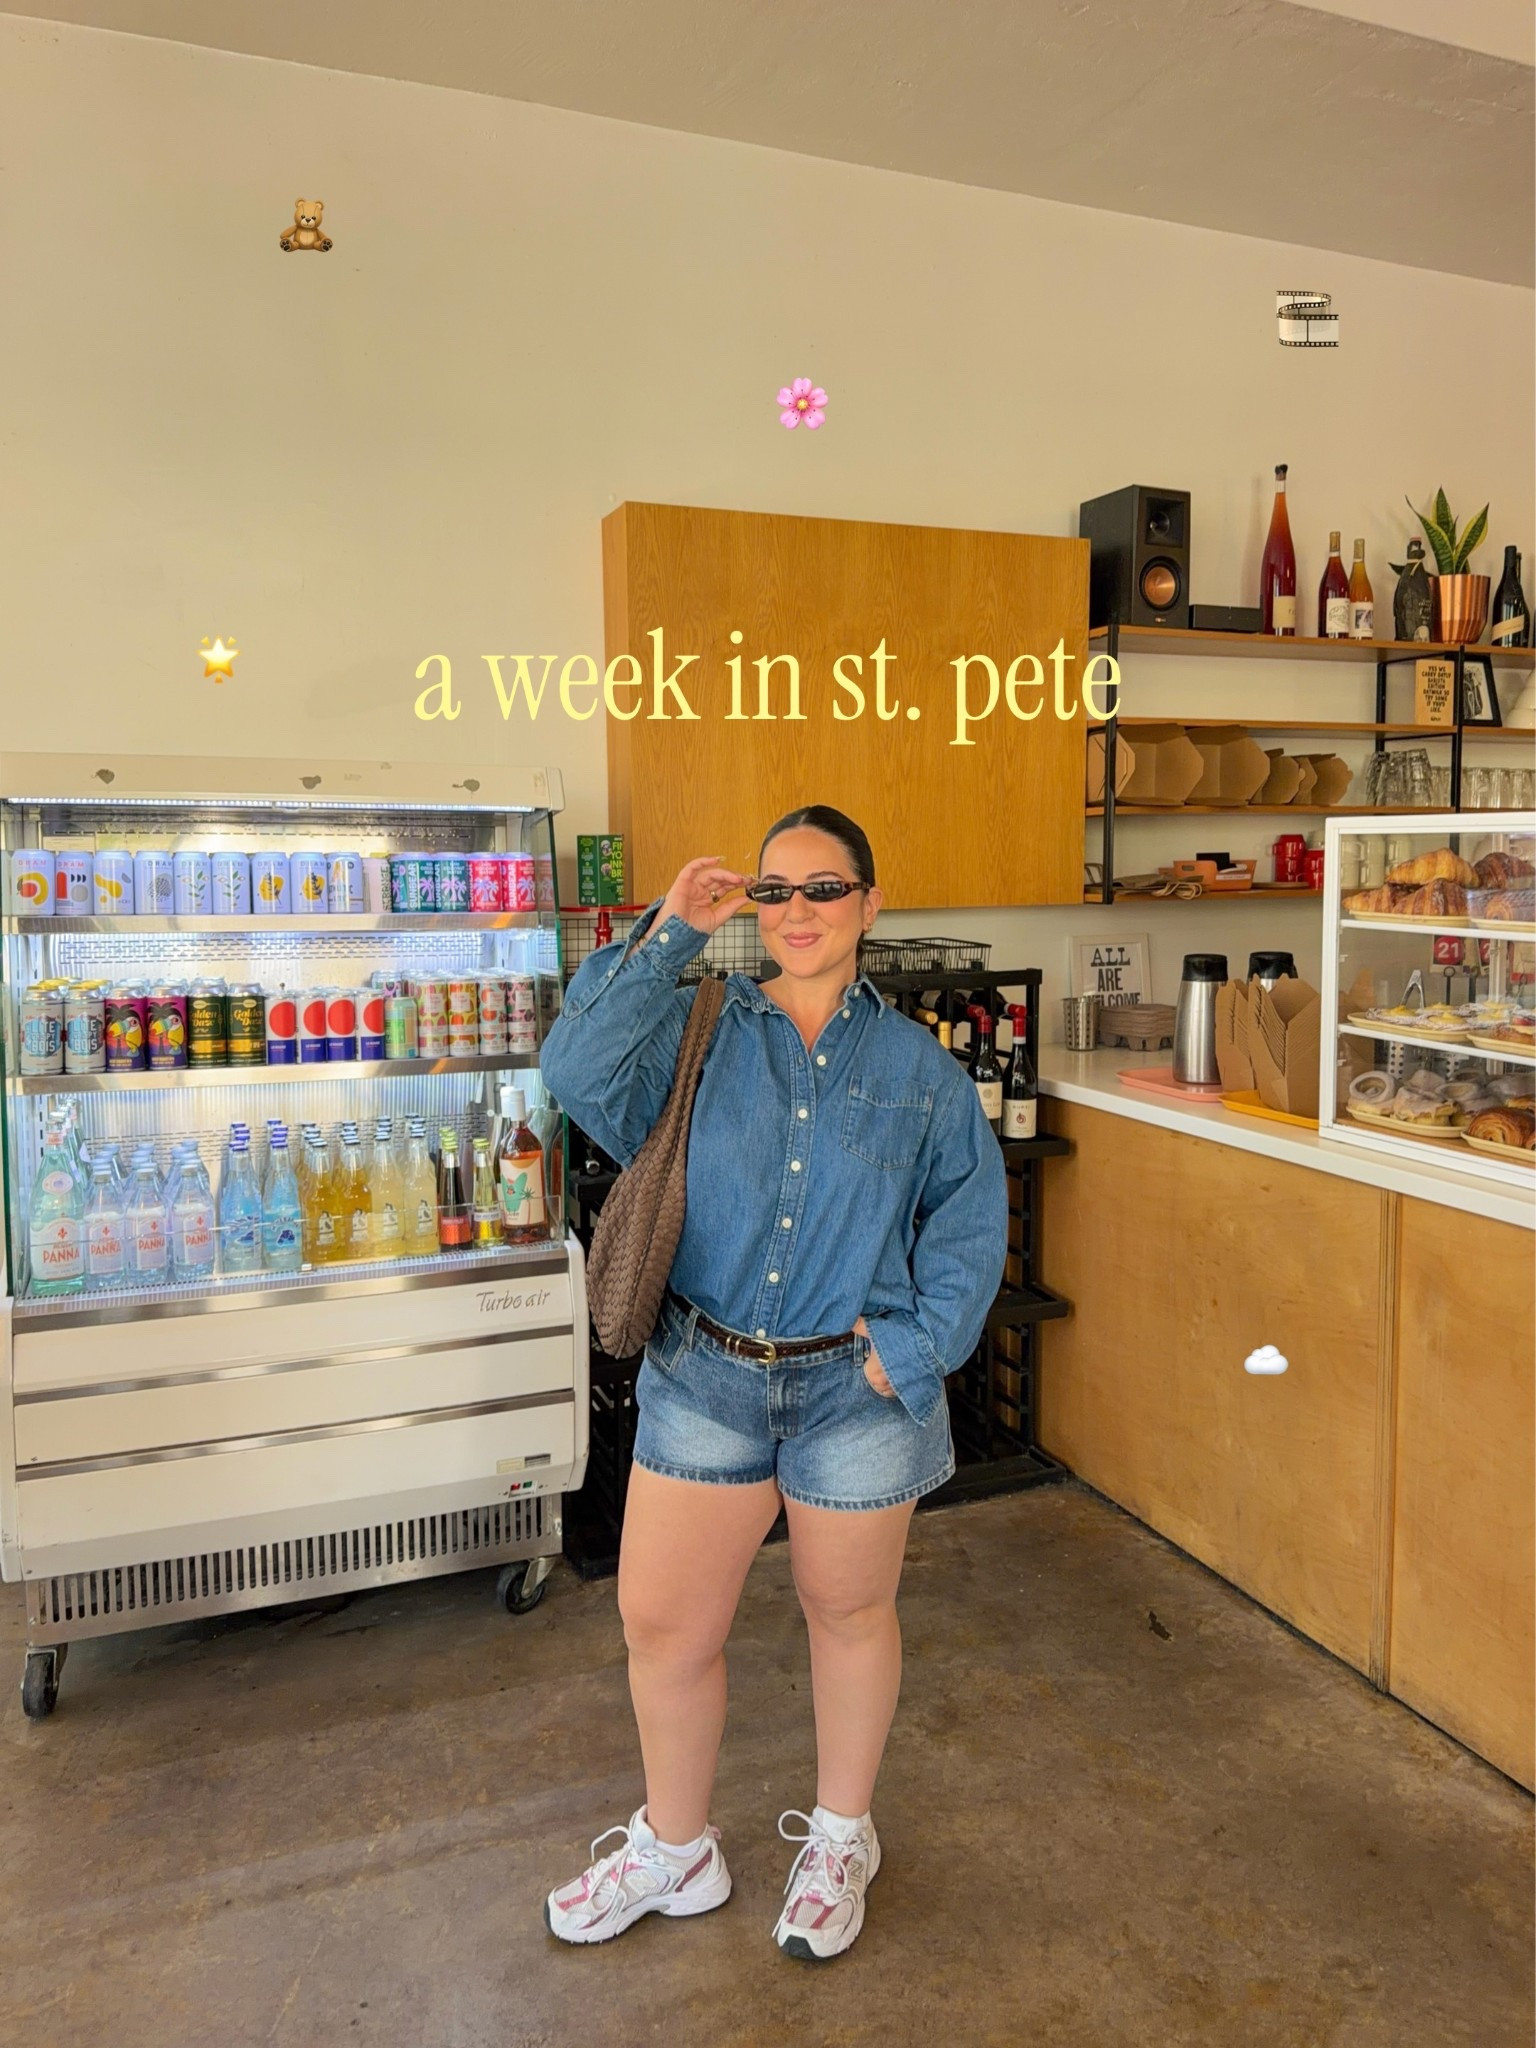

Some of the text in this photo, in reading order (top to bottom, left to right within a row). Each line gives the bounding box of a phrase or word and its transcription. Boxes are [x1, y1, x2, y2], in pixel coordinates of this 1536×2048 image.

[408, 862, 418, 908] SUNBEAR
[1090, 947, 1131, 968] ALL
[1438, 942, 1460, 959] 21
[1097, 967, 1124, 993] ARE
[42, 1248, 80, 1264] PANNA
[90, 1241, 121, 1255] PANNA
[475, 1289, 551, 1312] Turbo air
